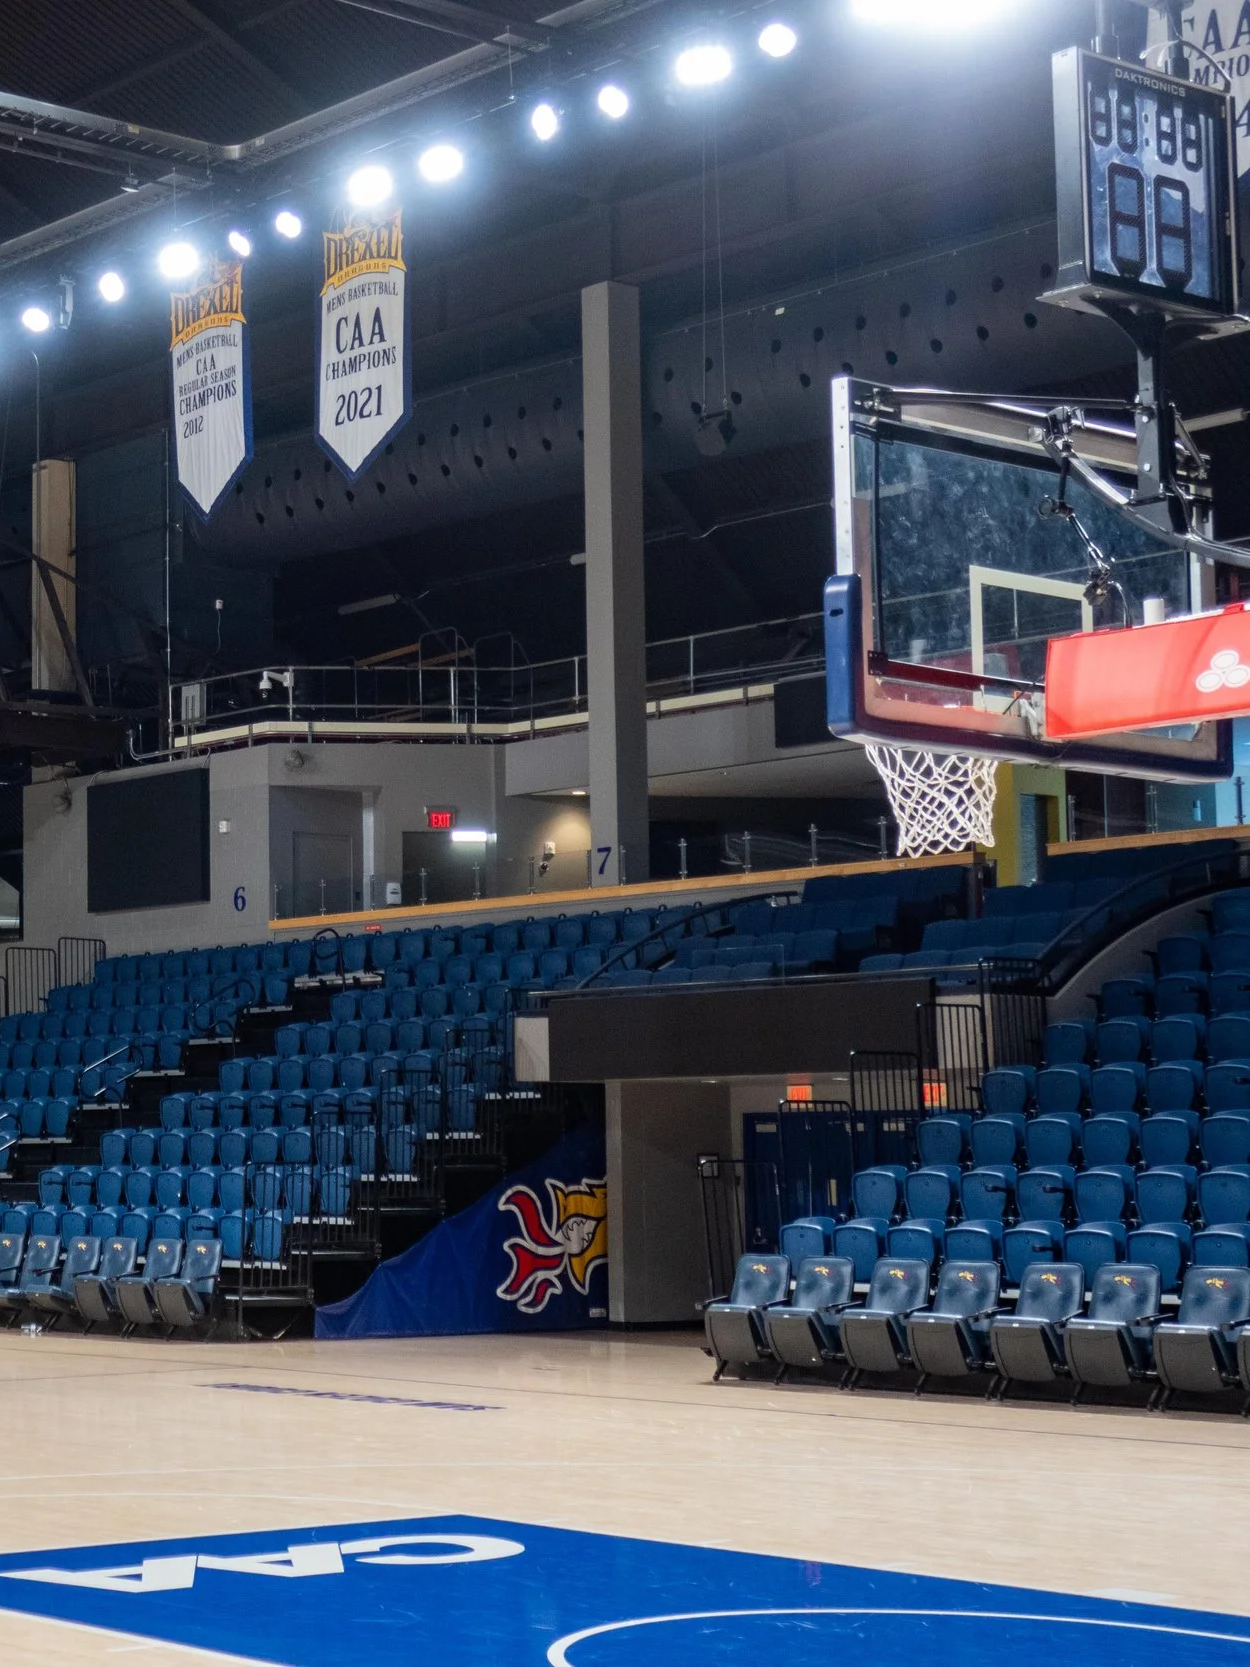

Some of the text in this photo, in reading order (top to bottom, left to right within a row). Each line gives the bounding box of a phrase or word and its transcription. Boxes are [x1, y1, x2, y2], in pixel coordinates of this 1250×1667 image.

[1114, 67, 1186, 98] DAKTRONICS
[325, 222, 399, 281] DREXEL
[326, 280, 399, 315] MENS BASKETBALL
[335, 306, 387, 354] CAA
[176, 334, 238, 369] MENS BASKETBALL
[196, 353, 217, 376] CAA
[325, 346, 397, 382] CHAMPIONS
[178, 365, 237, 398] REGULAR SEASON
[179, 380, 237, 416] CHAMPIONS
[335, 384, 383, 427] 2021
[183, 415, 204, 439] 2012
[432, 812, 451, 828] EXIT
[597, 846, 612, 875] 7
[233, 886, 247, 912] 6
